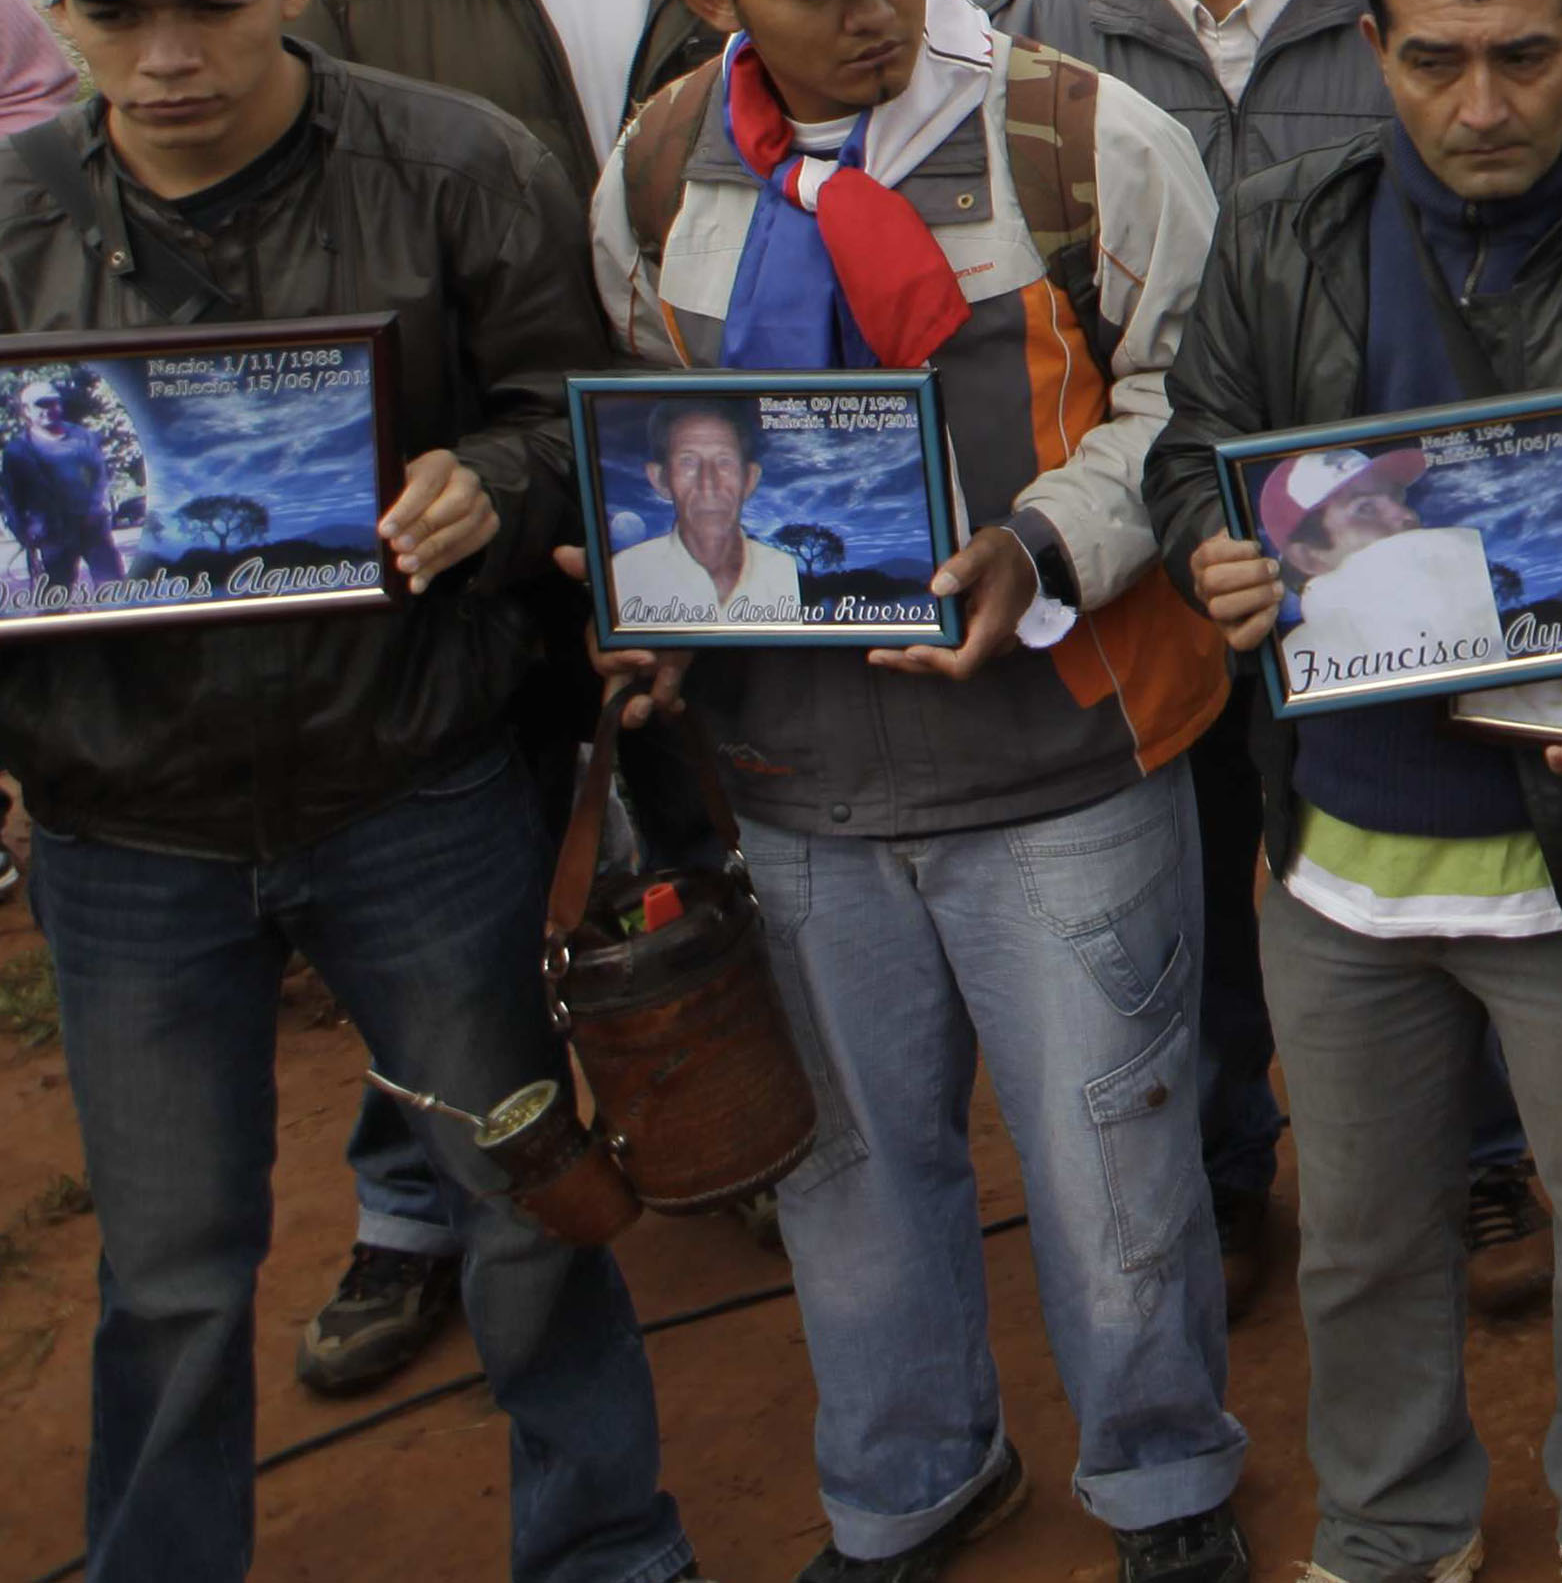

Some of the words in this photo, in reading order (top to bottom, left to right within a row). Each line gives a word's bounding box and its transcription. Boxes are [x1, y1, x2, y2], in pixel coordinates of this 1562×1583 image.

[223, 349, 343, 376] 1/11/1988
[620, 595, 718, 623] Andres
[728, 595, 825, 623] Avelino
[834, 595, 937, 623] Riveros
[1290, 630, 1490, 694] Francisco
